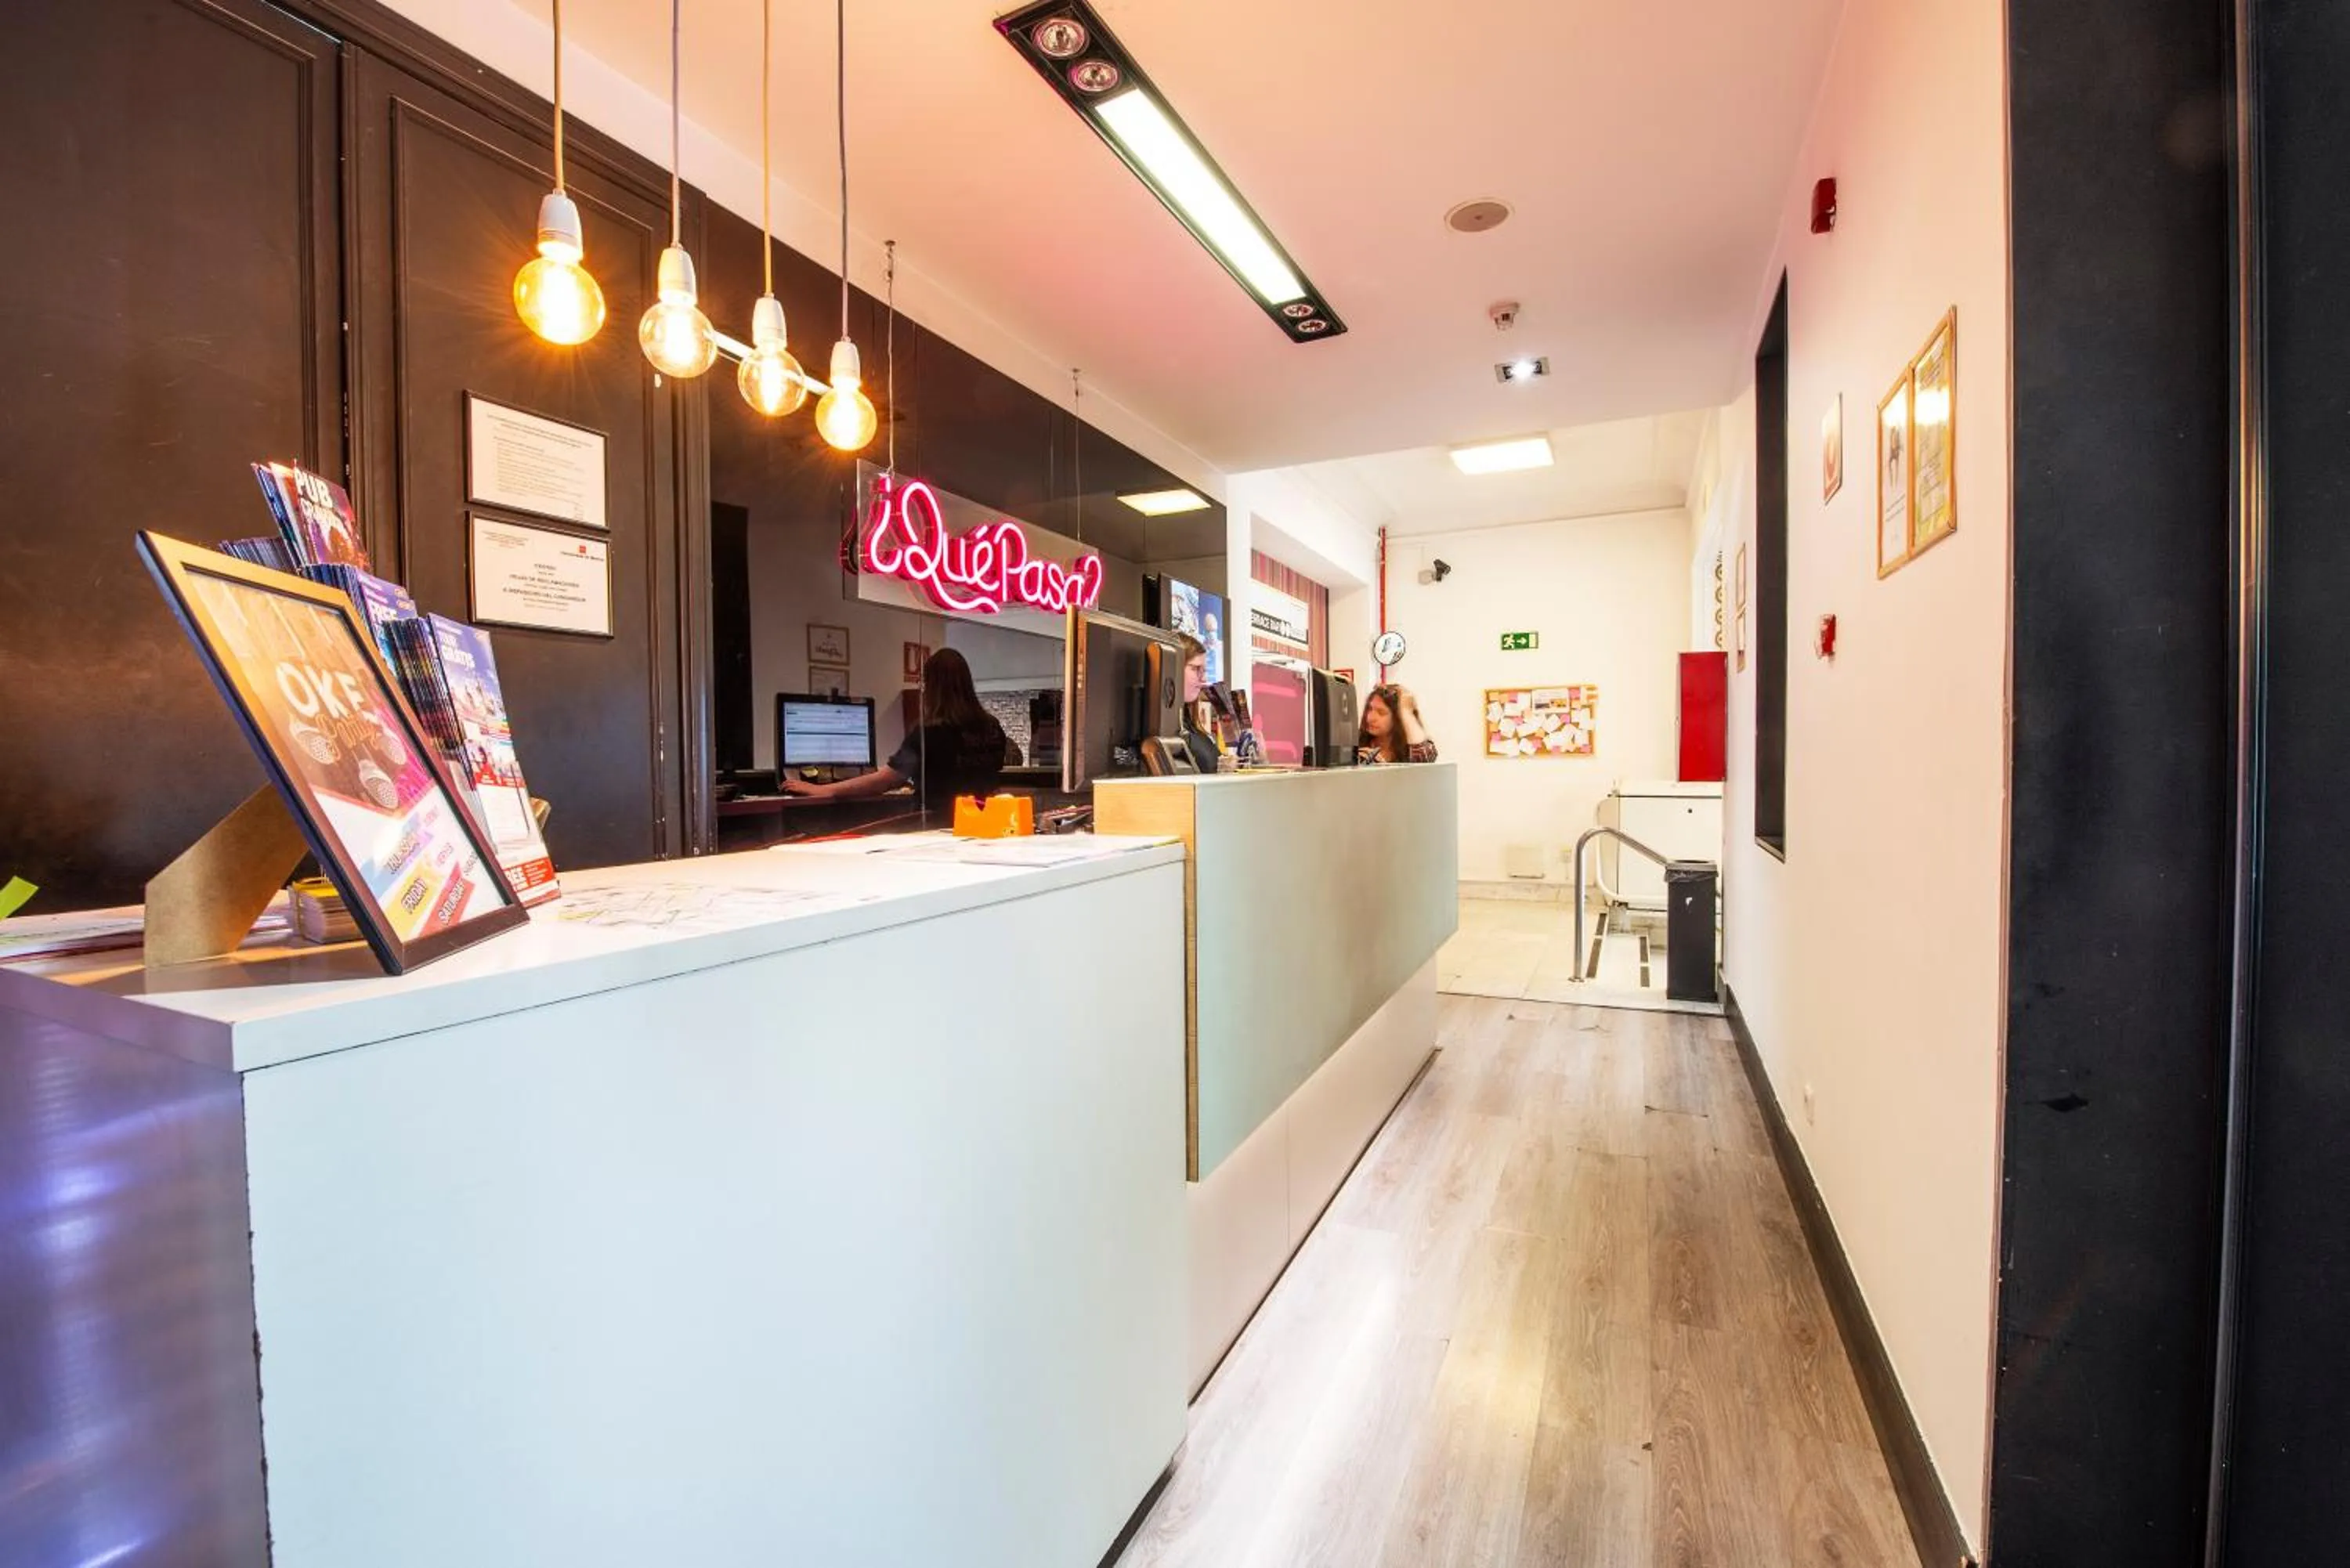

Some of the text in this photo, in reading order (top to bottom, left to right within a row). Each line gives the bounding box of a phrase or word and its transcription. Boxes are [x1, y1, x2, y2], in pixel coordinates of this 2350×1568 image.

[294, 466, 333, 509] PUB
[400, 876, 428, 916] FRIDAY
[438, 876, 465, 927] SATURDAY
